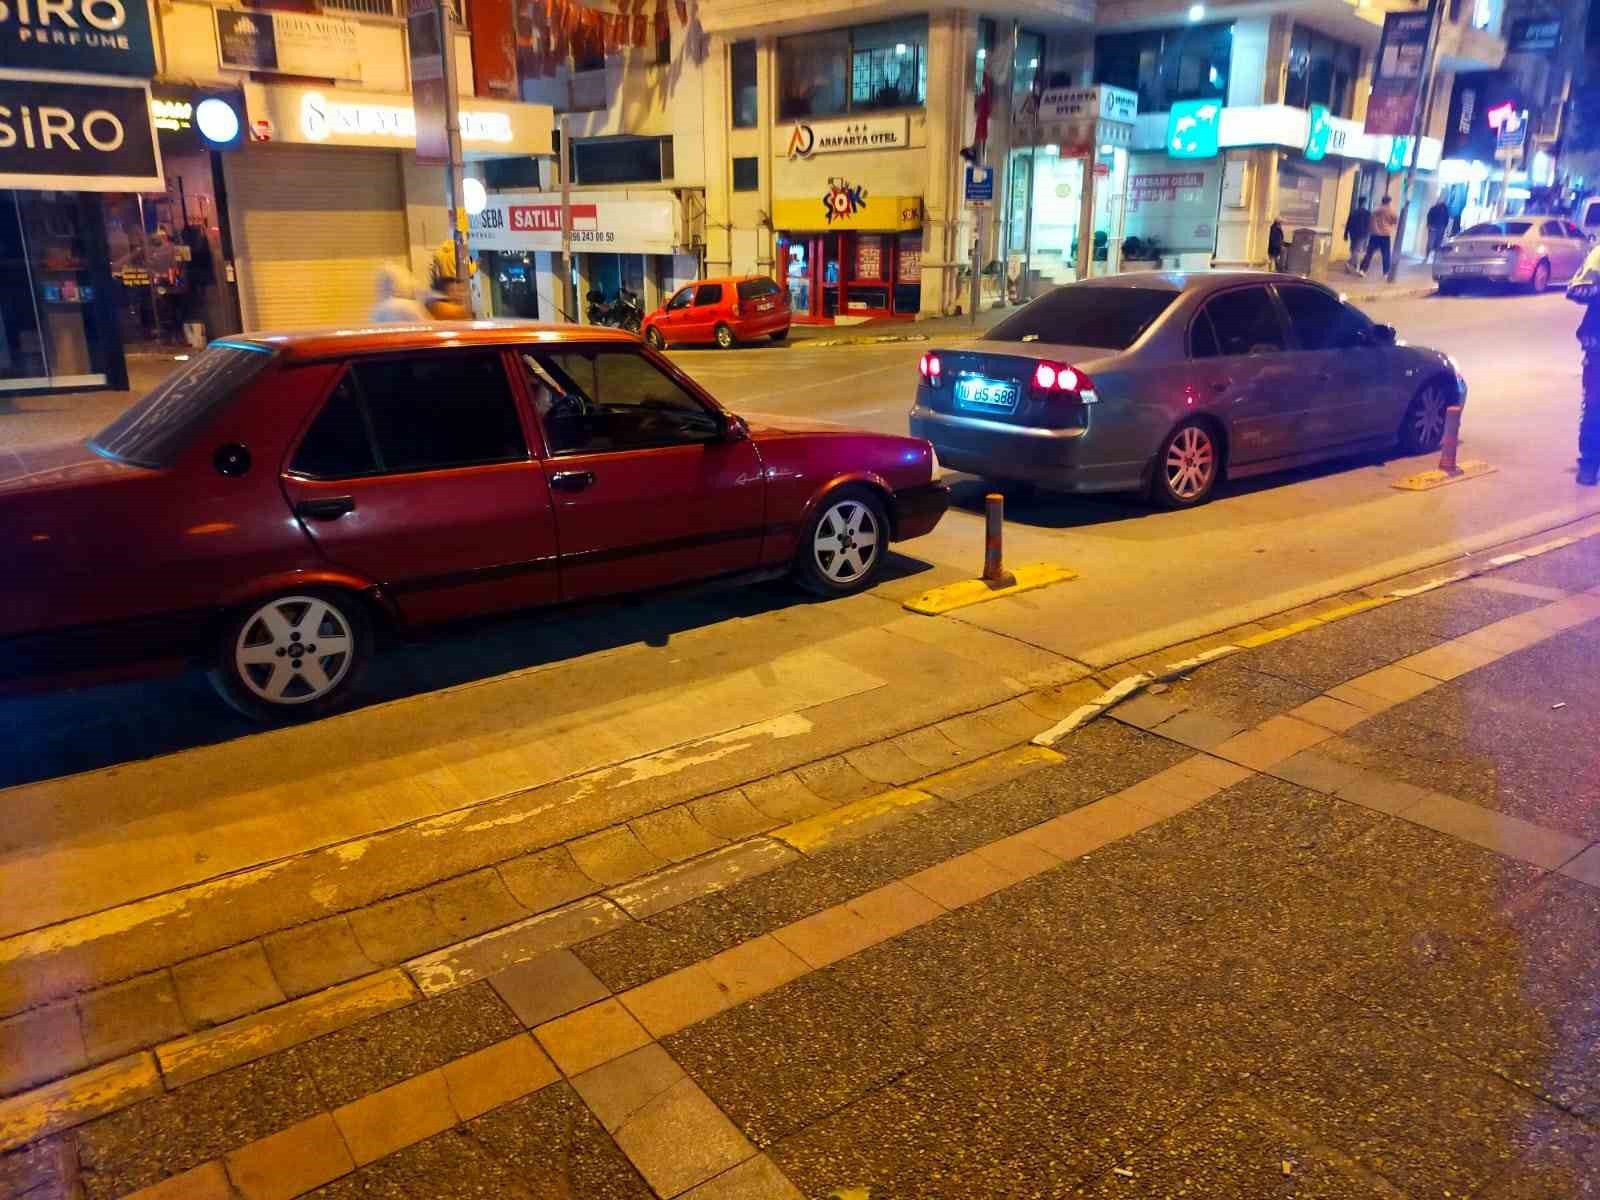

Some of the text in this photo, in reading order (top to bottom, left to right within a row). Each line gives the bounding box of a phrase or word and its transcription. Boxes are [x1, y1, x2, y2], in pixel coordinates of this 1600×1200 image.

[19, 27, 130, 50] PERFUME
[870, 132, 898, 144] OTEL
[481, 208, 504, 229] SEBA
[514, 209, 562, 228] SATILI
[993, 388, 1014, 405] 588
